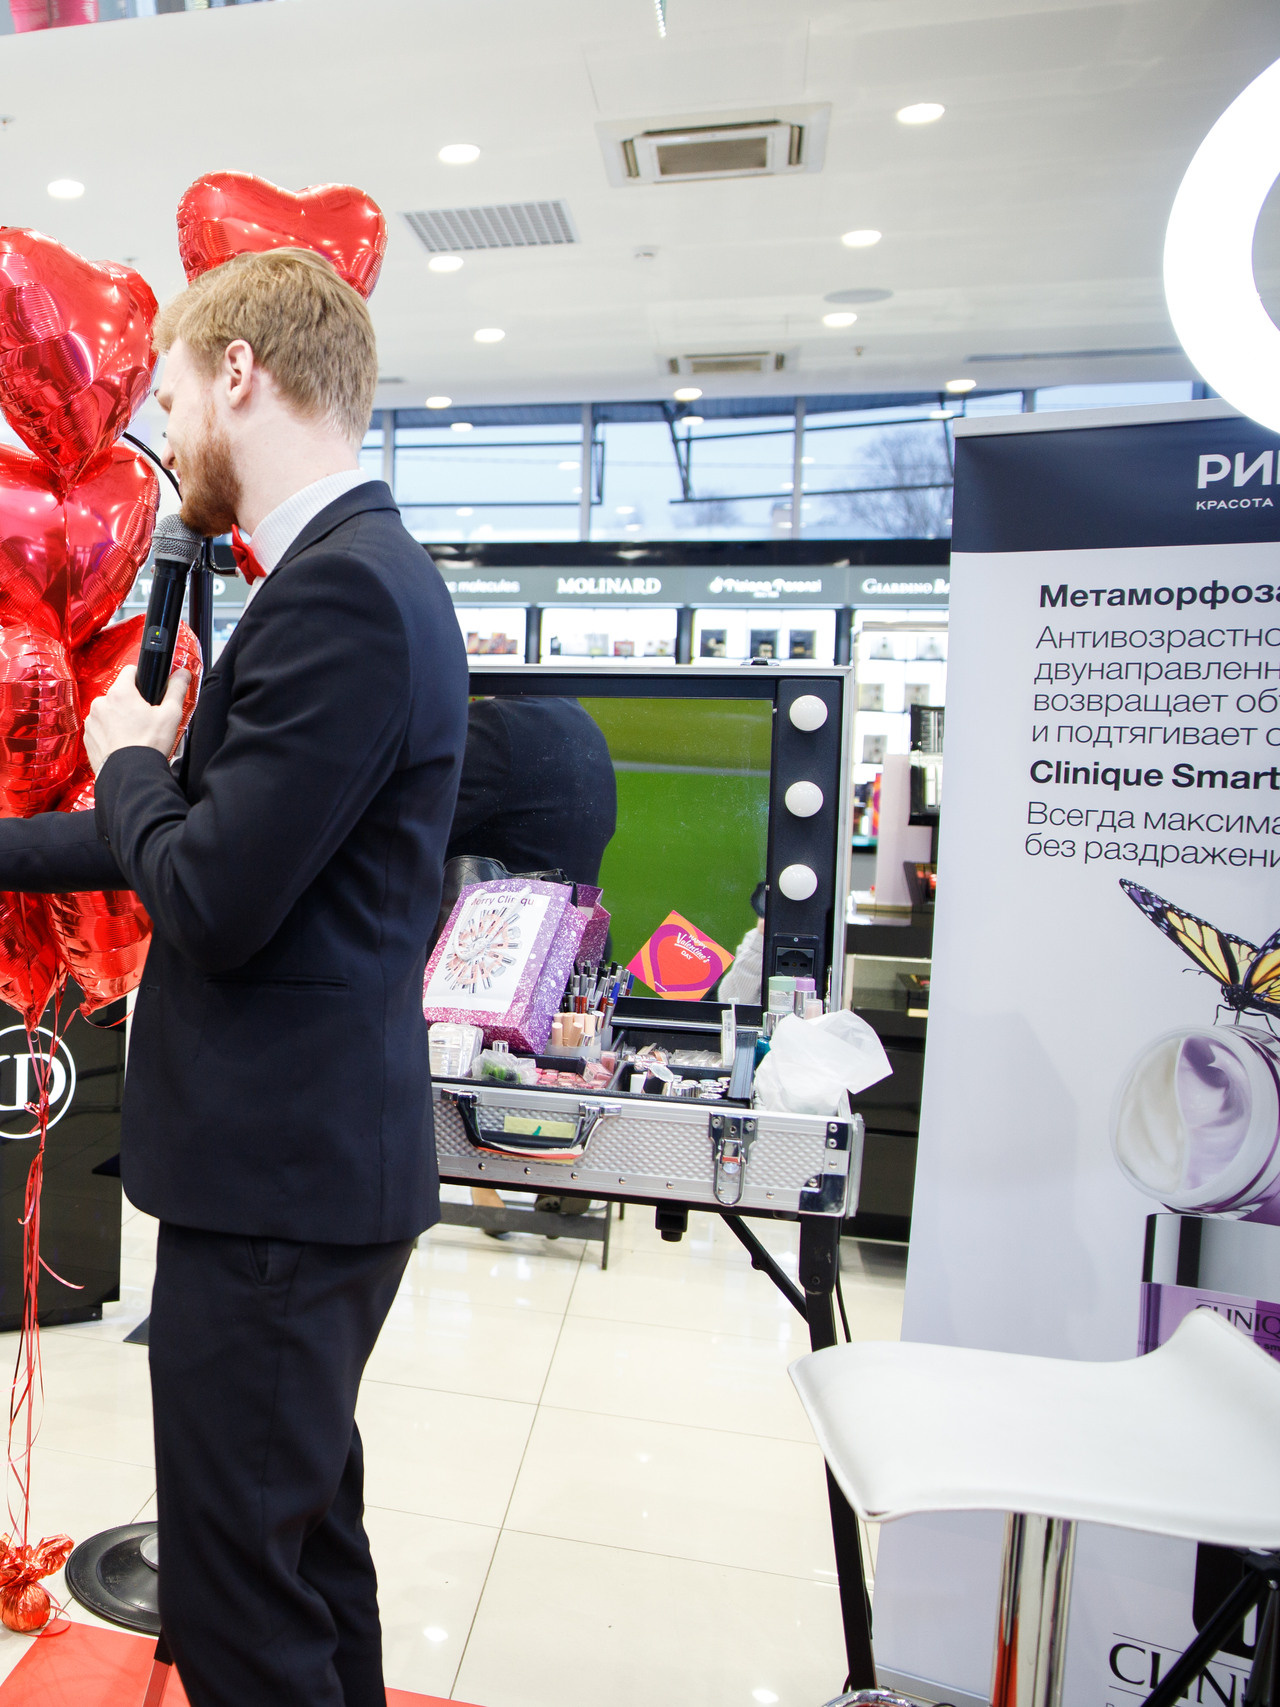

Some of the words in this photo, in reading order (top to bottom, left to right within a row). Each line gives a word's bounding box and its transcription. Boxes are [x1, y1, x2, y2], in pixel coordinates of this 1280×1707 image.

[1197, 450, 1280, 489] РИ
[1196, 498, 1274, 511] КРАСОТА
[557, 577, 663, 595] MOLINARD
[1034, 694, 1229, 717] возвращает
[1236, 688, 1280, 713] об
[1032, 725, 1049, 742] и
[1057, 725, 1258, 748] подтягивает
[1030, 760, 1163, 791] Clinique
[1171, 763, 1280, 790] Smart
[1027, 801, 1136, 833] Всегда
[1025, 832, 1076, 857] без
[680, 950, 694, 961] DAY
[1196, 1304, 1280, 1339] INIQ
